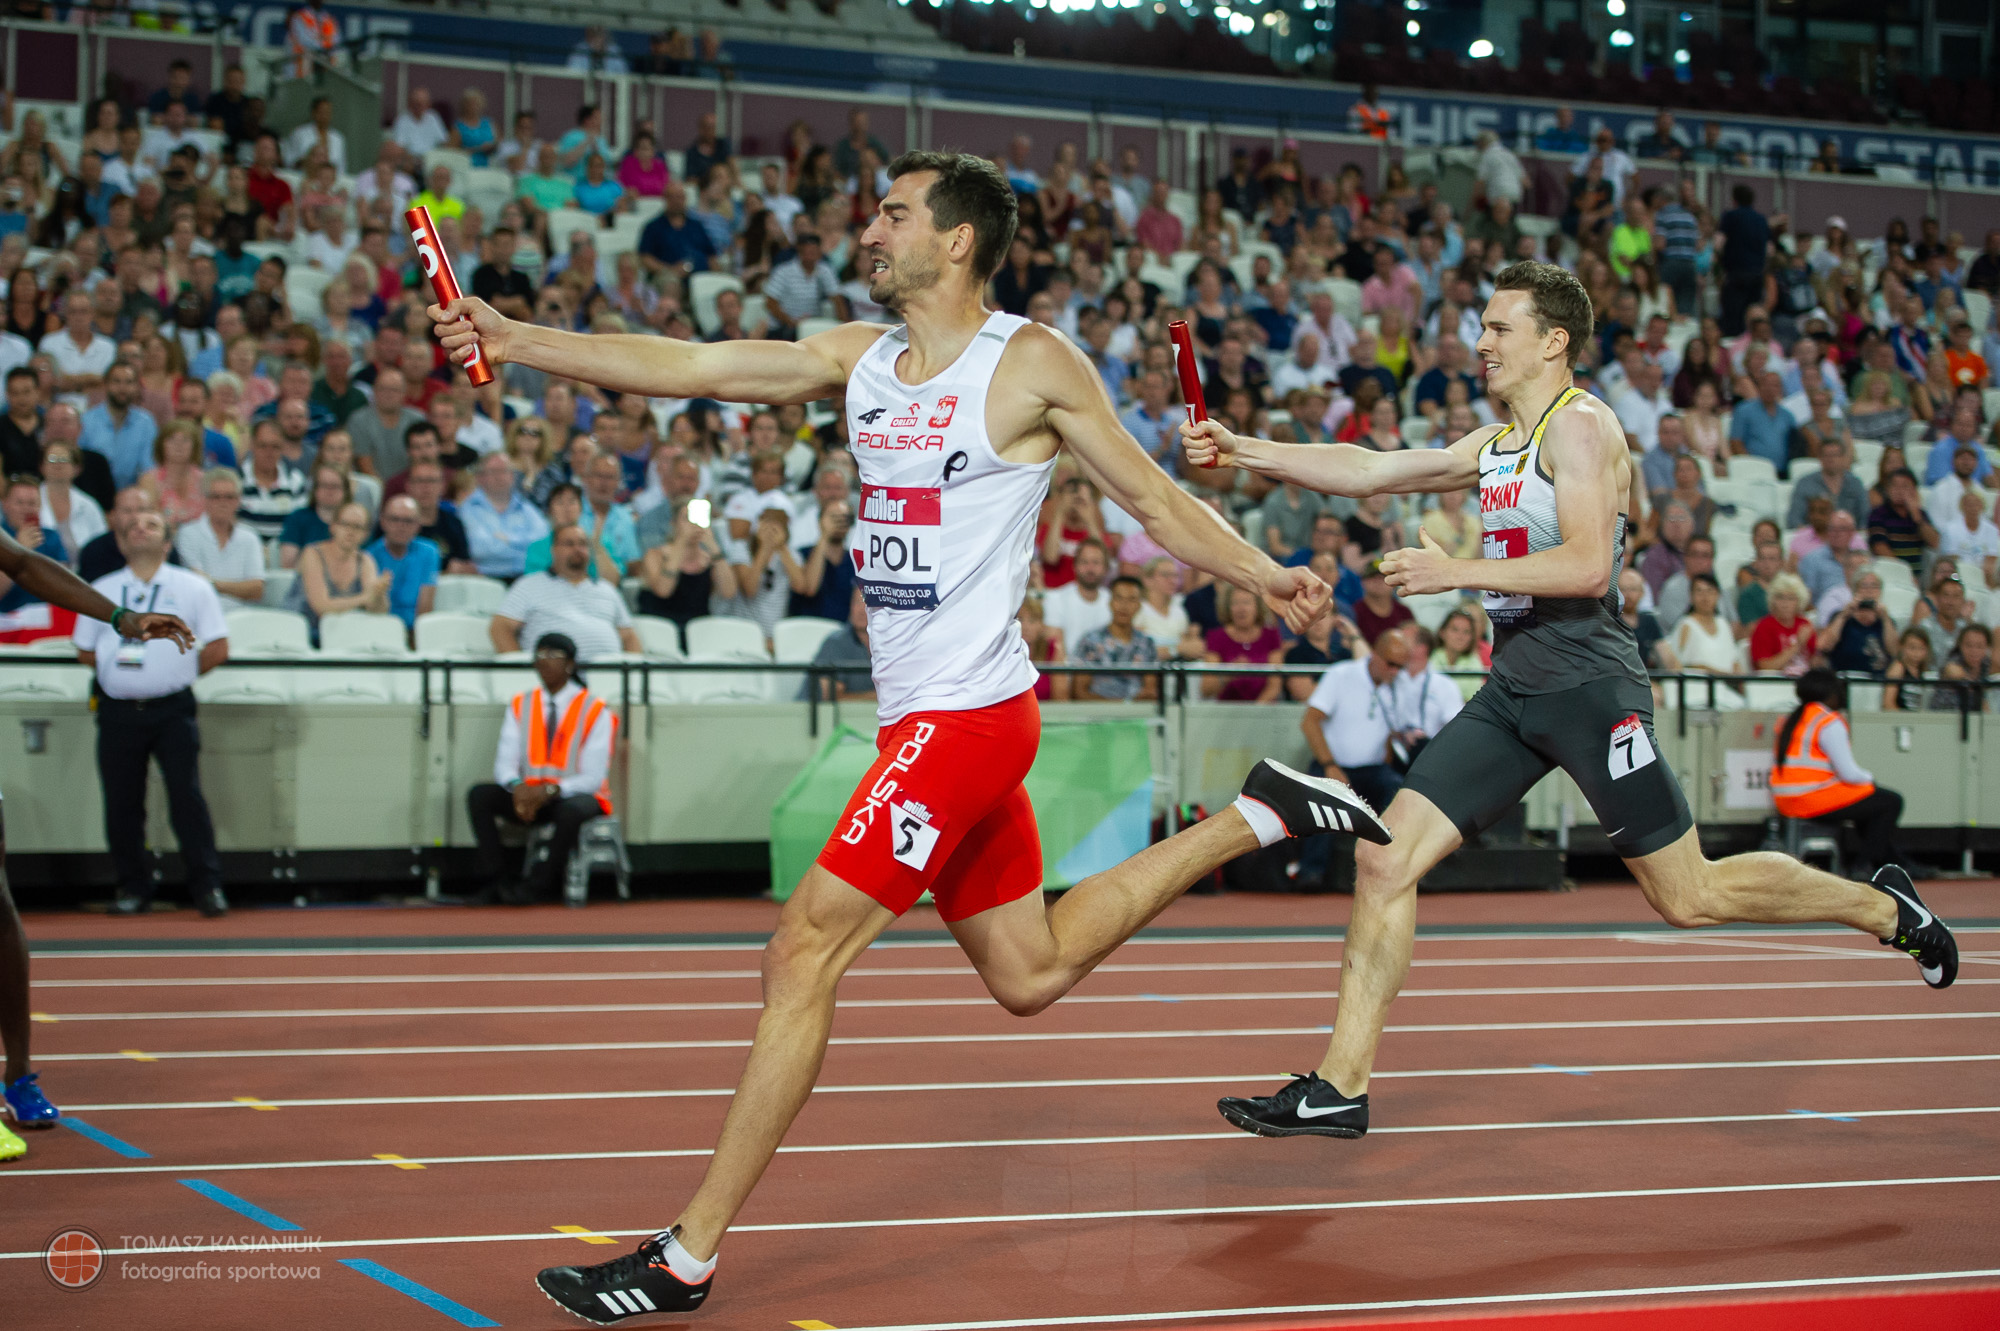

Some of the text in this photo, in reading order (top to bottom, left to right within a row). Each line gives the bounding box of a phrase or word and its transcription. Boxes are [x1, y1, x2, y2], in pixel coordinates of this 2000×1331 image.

[892, 418, 917, 427] ORLEN
[857, 432, 944, 452] POLSKA
[1498, 463, 1515, 476] DKB
[869, 533, 933, 572] POL
[1483, 534, 1508, 559] üller
[891, 588, 916, 598] WORLD
[916, 589, 932, 599] CUP
[1614, 736, 1635, 771] 7
[840, 721, 936, 845] POLSKA
[902, 799, 933, 823] müller
[894, 816, 923, 856] 5
